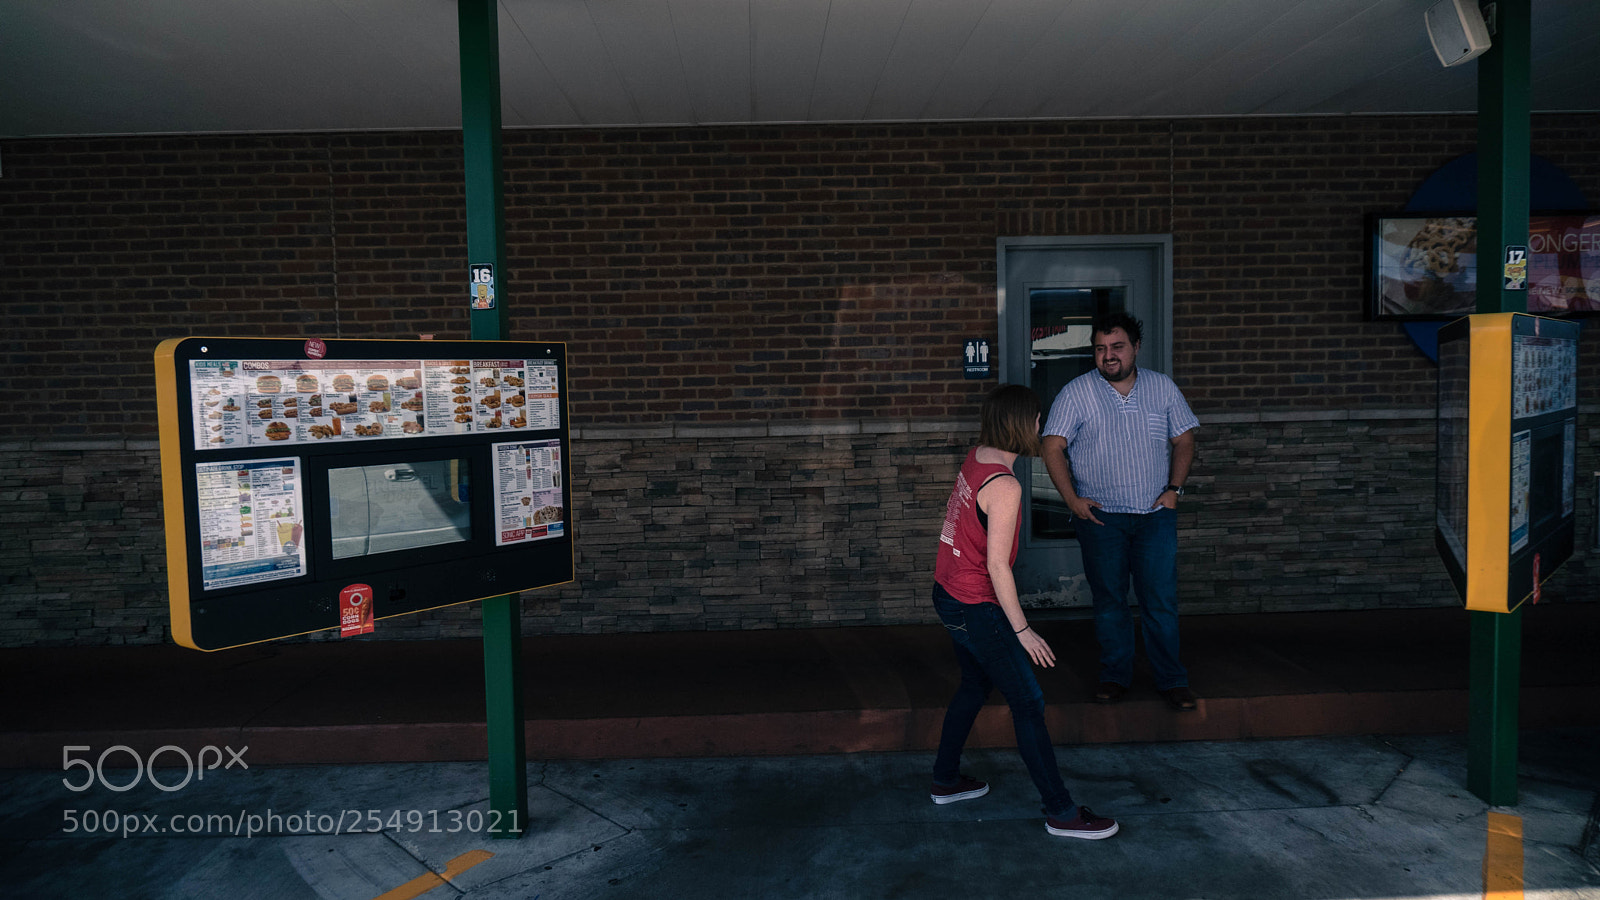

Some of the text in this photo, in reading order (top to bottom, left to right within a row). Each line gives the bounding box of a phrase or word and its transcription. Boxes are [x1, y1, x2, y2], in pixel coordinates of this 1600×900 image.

[1508, 250, 1524, 265] 17
[473, 268, 491, 283] 16
[243, 362, 269, 370] COMBOS
[343, 607, 359, 617] 50¢
